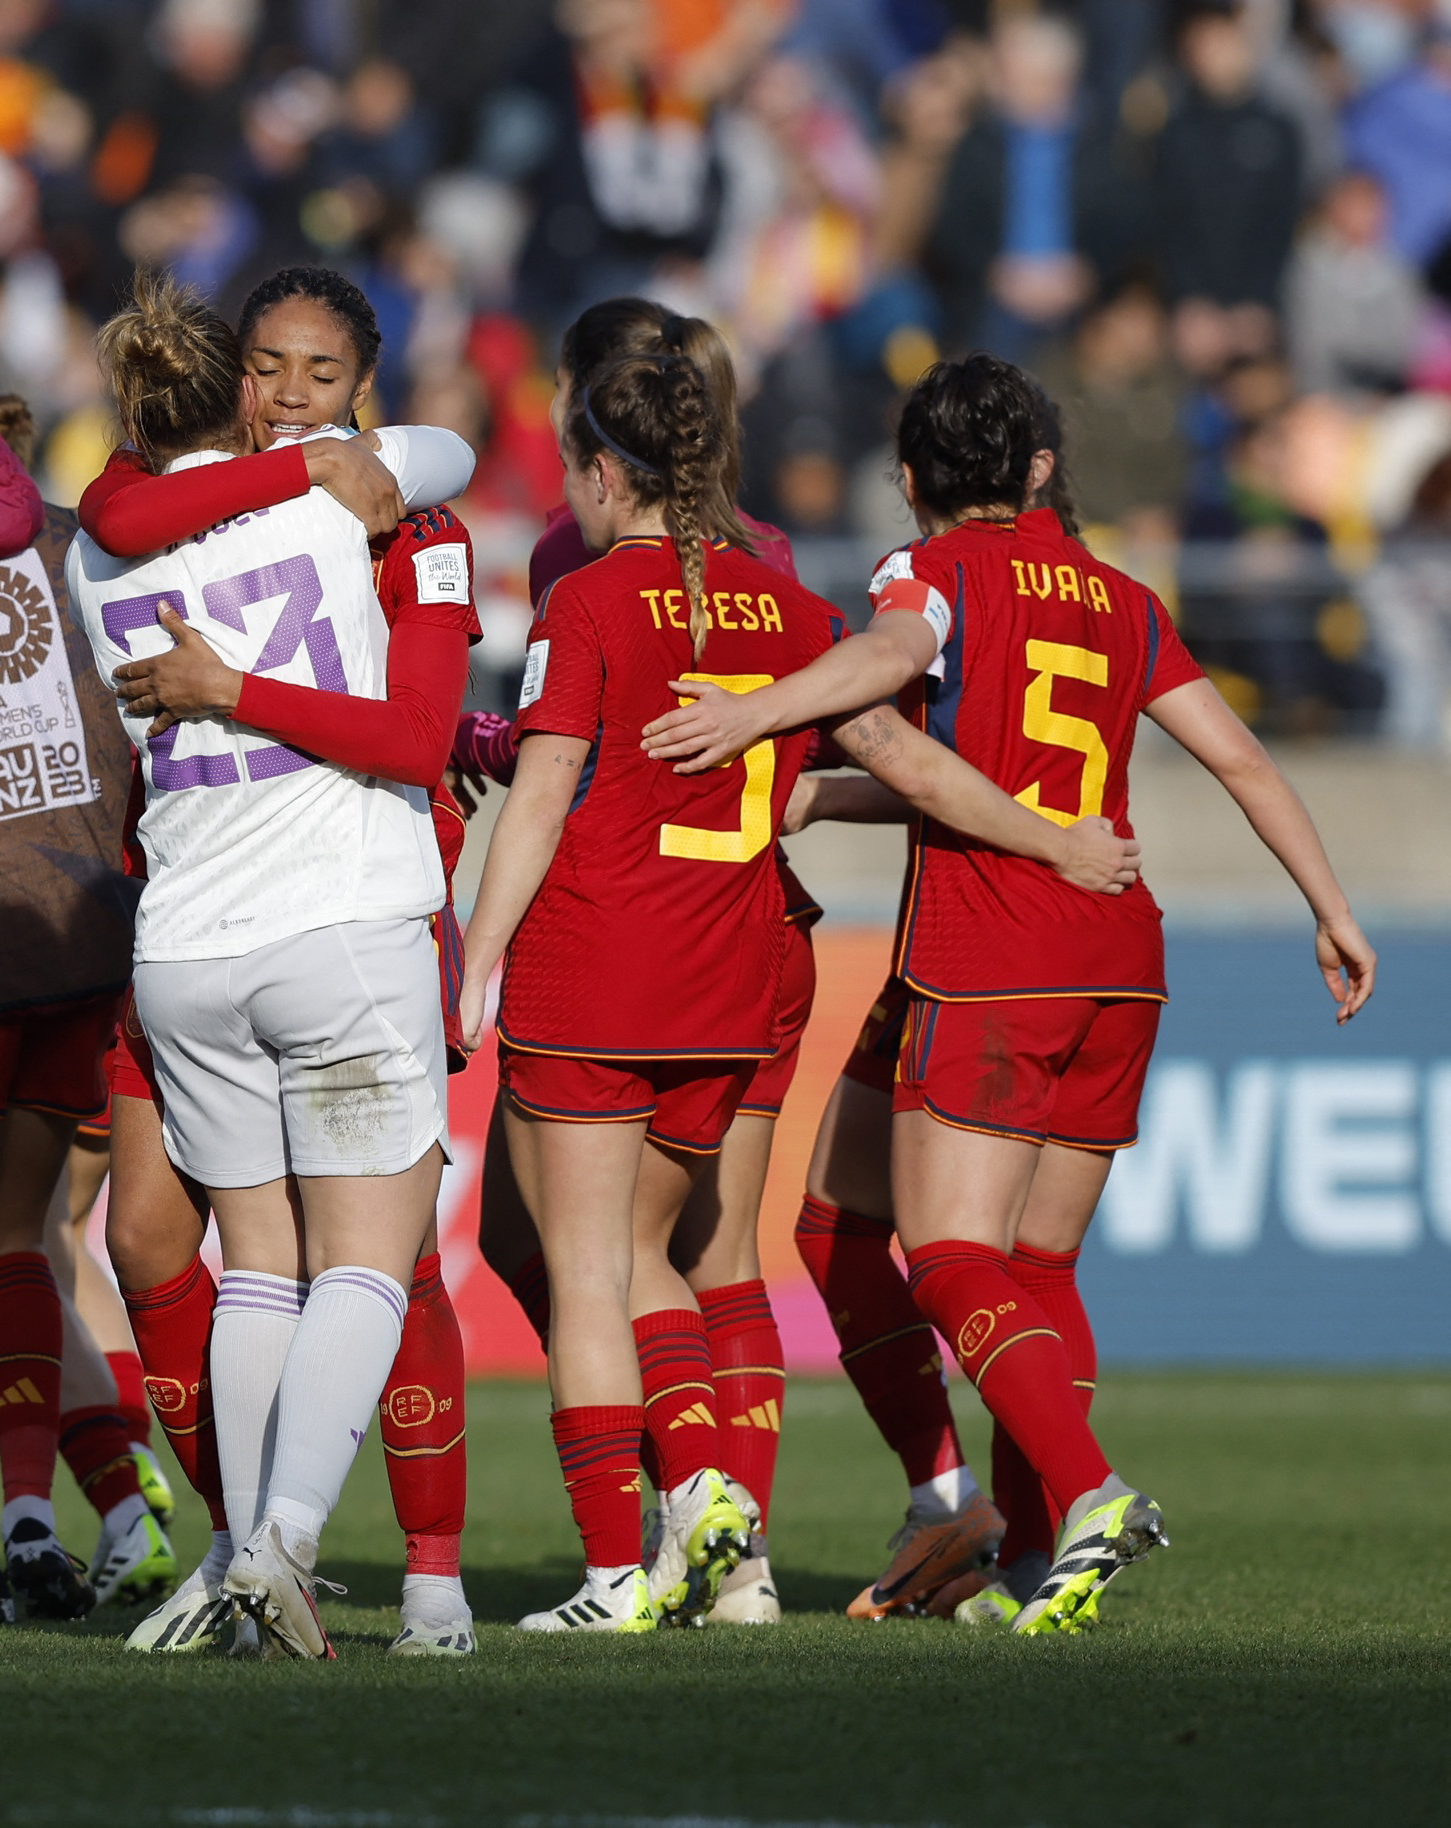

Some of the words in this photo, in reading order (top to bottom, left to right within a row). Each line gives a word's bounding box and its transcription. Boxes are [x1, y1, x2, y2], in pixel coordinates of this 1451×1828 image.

[427, 553, 457, 563] FOOTBALL
[429, 561, 459, 572] UNITES
[439, 583, 454, 591] FIFA
[1011, 559, 1112, 613] IVAA
[34, 717, 59, 733] CUP
[1013, 638, 1109, 829] 5
[41, 741, 79, 771] 20
[659, 672, 776, 863] 3
[48, 769, 86, 800] 23
[1093, 1058, 1451, 1256] WE
[396, 1394, 422, 1407] RF
[439, 1397, 452, 1413] 09
[398, 1405, 422, 1418] EF
